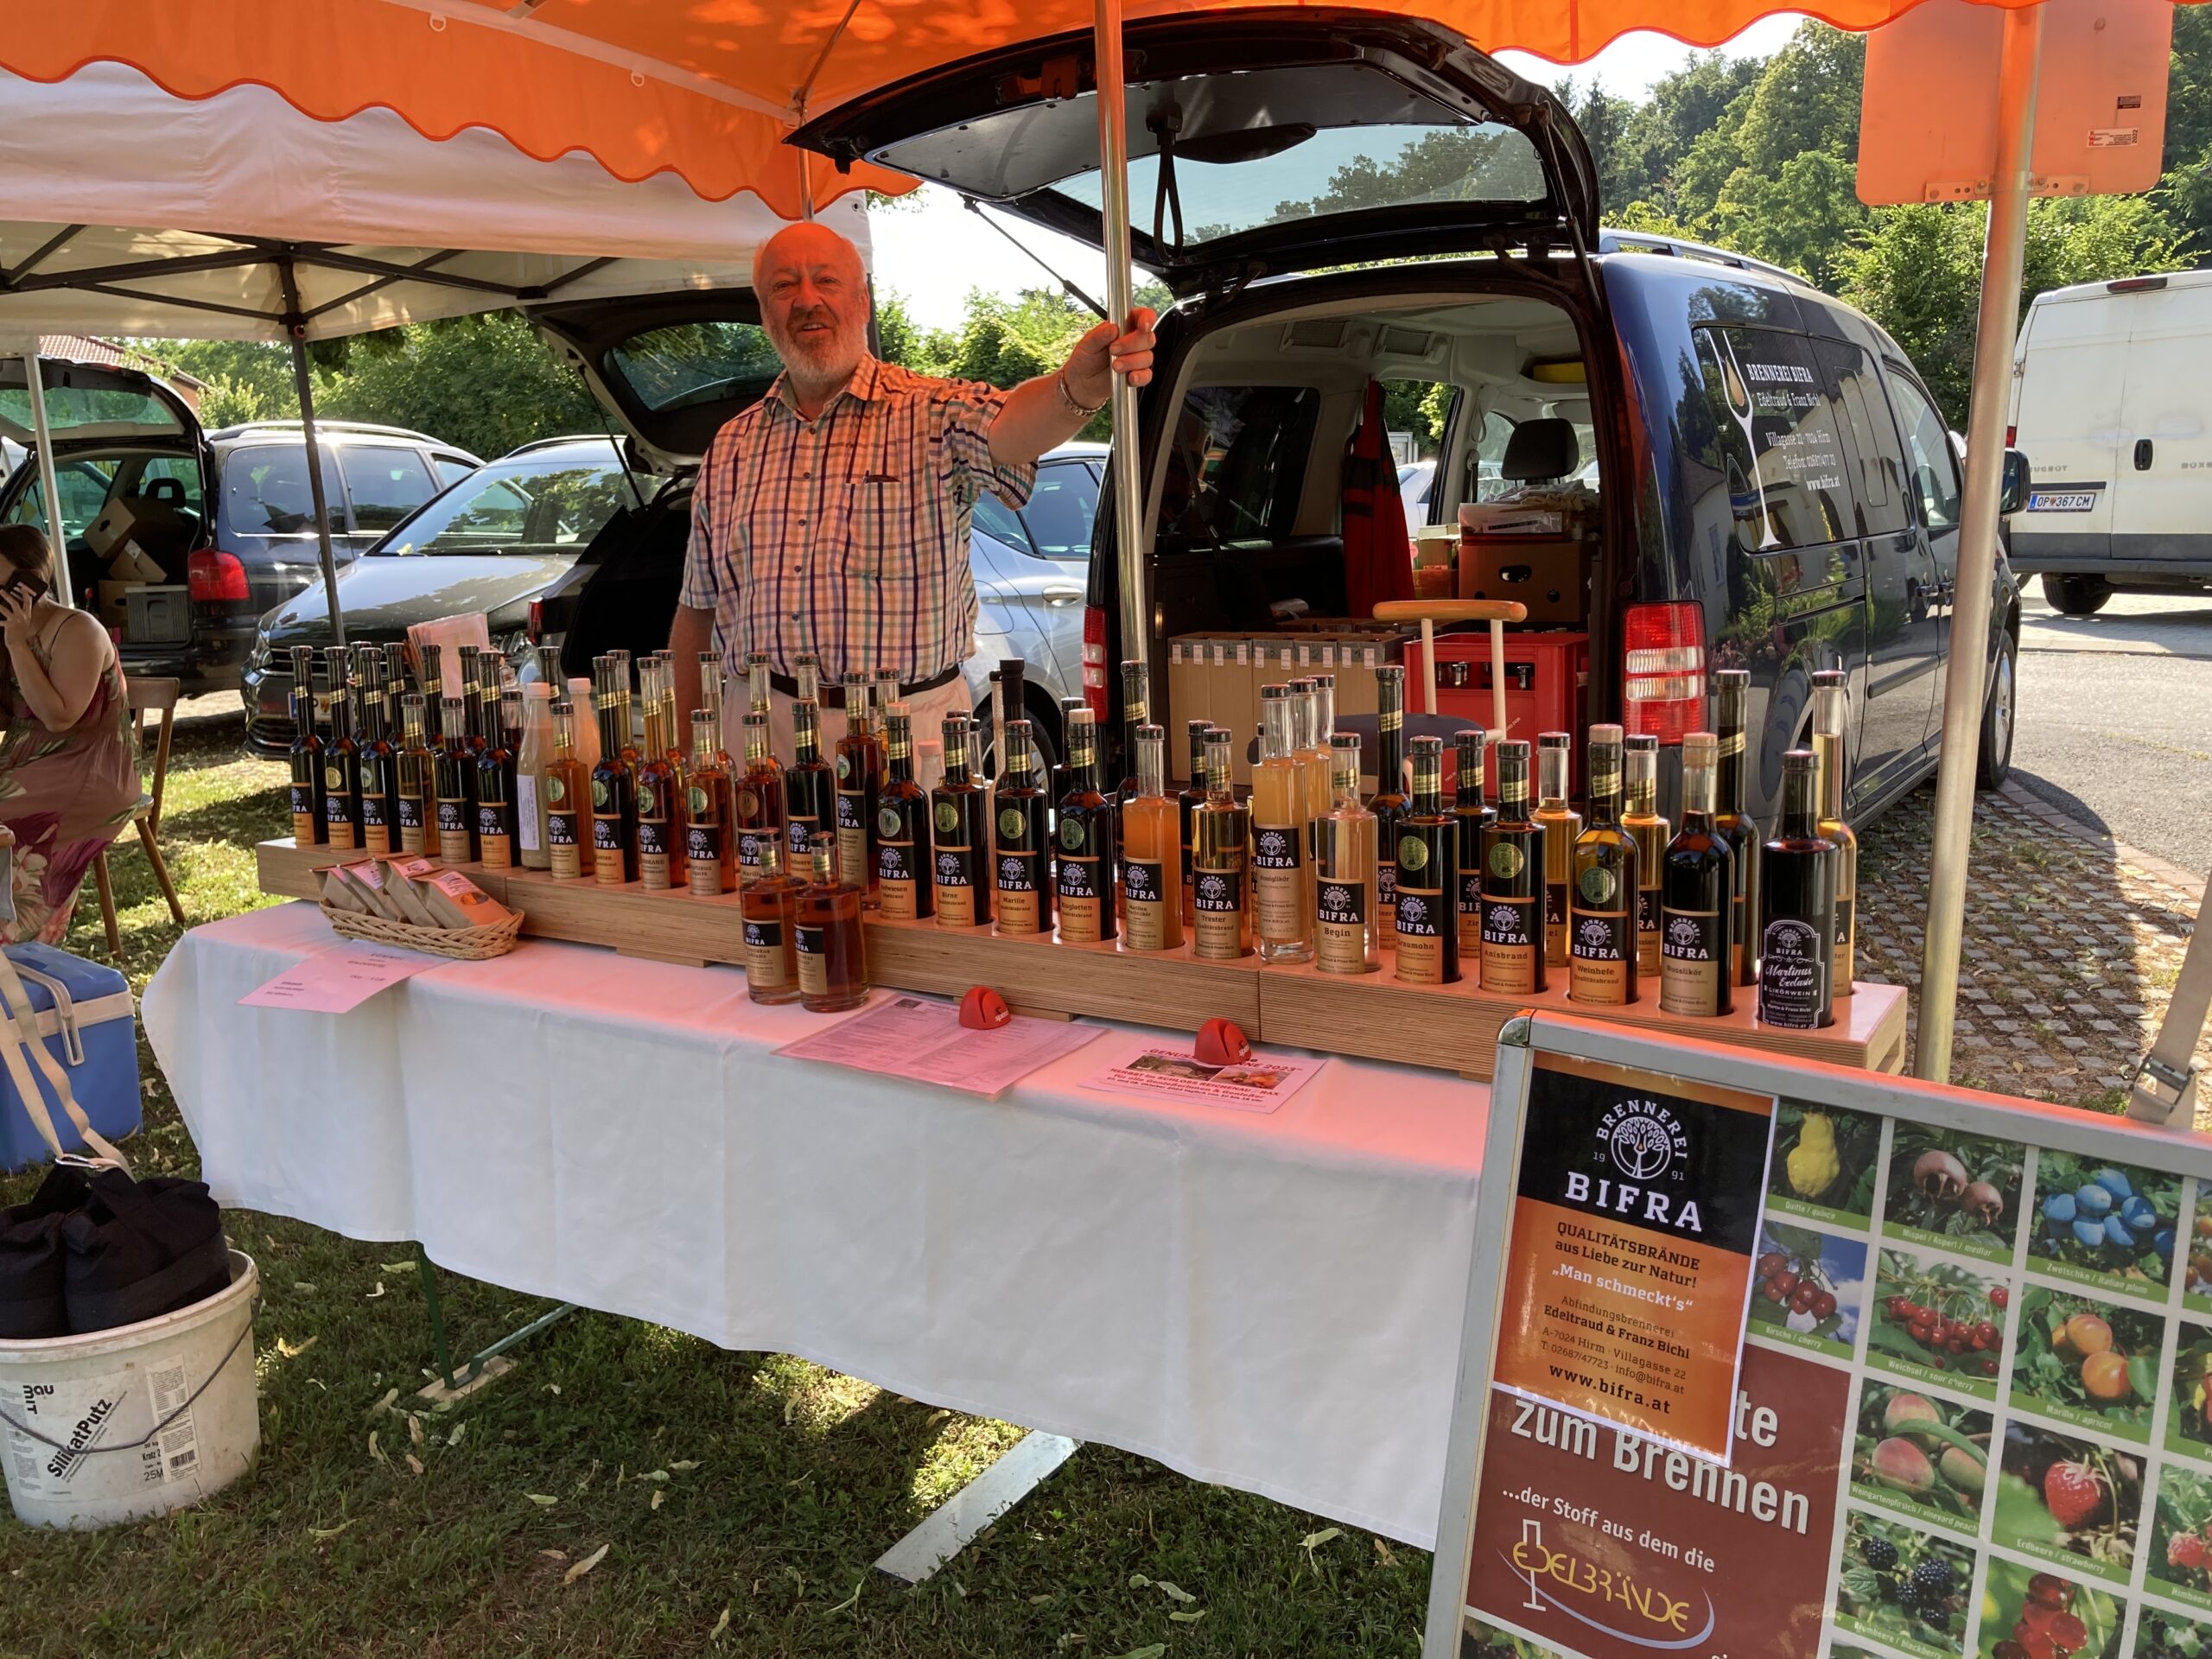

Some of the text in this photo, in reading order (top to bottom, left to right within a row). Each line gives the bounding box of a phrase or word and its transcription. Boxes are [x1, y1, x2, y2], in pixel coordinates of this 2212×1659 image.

[1745, 364, 1814, 383] BRENNEREI BIFRA
[1757, 392, 1787, 406] Edeltraud
[1791, 392, 1808, 406] Franz
[1765, 432, 1796, 449] Villagasse
[1806, 474, 1841, 491] www.bifra.at
[2037, 496, 2091, 507] OP 367 CM
[1256, 855, 1294, 868] BIFRA
[879, 867, 909, 879] BIFRA
[936, 874, 968, 886] BIFRA
[998, 879, 1033, 890] BIFRA
[1060, 884, 1094, 896] BIFRA
[1125, 887, 1156, 899] BIFRA
[1196, 898, 1234, 910] BIFRA
[1201, 914, 1226, 923] Trester
[1319, 909, 1359, 922] BIFRA
[1324, 926, 1351, 938] Begin
[1396, 919, 1436, 934] BIFRA
[1484, 930, 1529, 944] BIFRA
[1484, 950, 1528, 960] Anisbrand
[1573, 944, 1619, 958] BIFRA
[1663, 943, 1709, 959] BIFRA
[1776, 947, 1803, 956] BIFRA
[1577, 964, 1615, 976] Weinhefe
[1765, 964, 1812, 977] Martinus
[1778, 976, 1815, 988] Exclusiv
[1769, 987, 1811, 996] LIKÖRWEIN
[1157, 1076, 1198, 1084] SCHLOSS
[1199, 1082, 1251, 1091] REICHENAU
[1596, 1099, 1688, 1159] BRENNEREI
[1592, 1151, 1684, 1181] 19 91
[1565, 1171, 1702, 1232] BIFRA
[1785, 1200, 1836, 1221] Quitte quince
[1557, 1222, 1700, 1270] QUALITÄTSBRÄNDE
[1903, 1227, 1928, 1242] Mispel
[1932, 1236, 1957, 1250] Asperl
[1555, 1240, 1697, 1288] aus Liebe zur Natur!
[2046, 1262, 2090, 1281] Zwetschke
[2126, 1283, 2149, 1295] plum
[1561, 1296, 1675, 1338] Abfindungsbrennerei
[1544, 1305, 1690, 1359] Edeltraud & Franz Bichl
[1765, 1325, 1822, 1349] Kirsche cherry
[1542, 1326, 1686, 1380] A-7024 Hirm Villagasse 22
[1551, 1343, 1609, 1370] 02687/47723
[1615, 1364, 1685, 1395] info@bifra.at
[1888, 1359, 1923, 1376] Weichsel
[1929, 1372, 1947, 1382] sour
[1549, 1364, 1671, 1414] www.bifra.at
[2046, 1404, 2113, 1431] Marille apricot
[1511, 1399, 1598, 1460] zum
[1613, 1429, 1810, 1535] Brennen
[1852, 1484, 1978, 1534] Weingartenpfirsich vineyard peach
[1553, 1497, 1599, 1529] Stoff
[1601, 1517, 1634, 1542] aus
[1638, 1529, 1679, 1560] dem
[1684, 1546, 1716, 1573] die
[2017, 1538, 2107, 1574] Erdbeere strawberry
